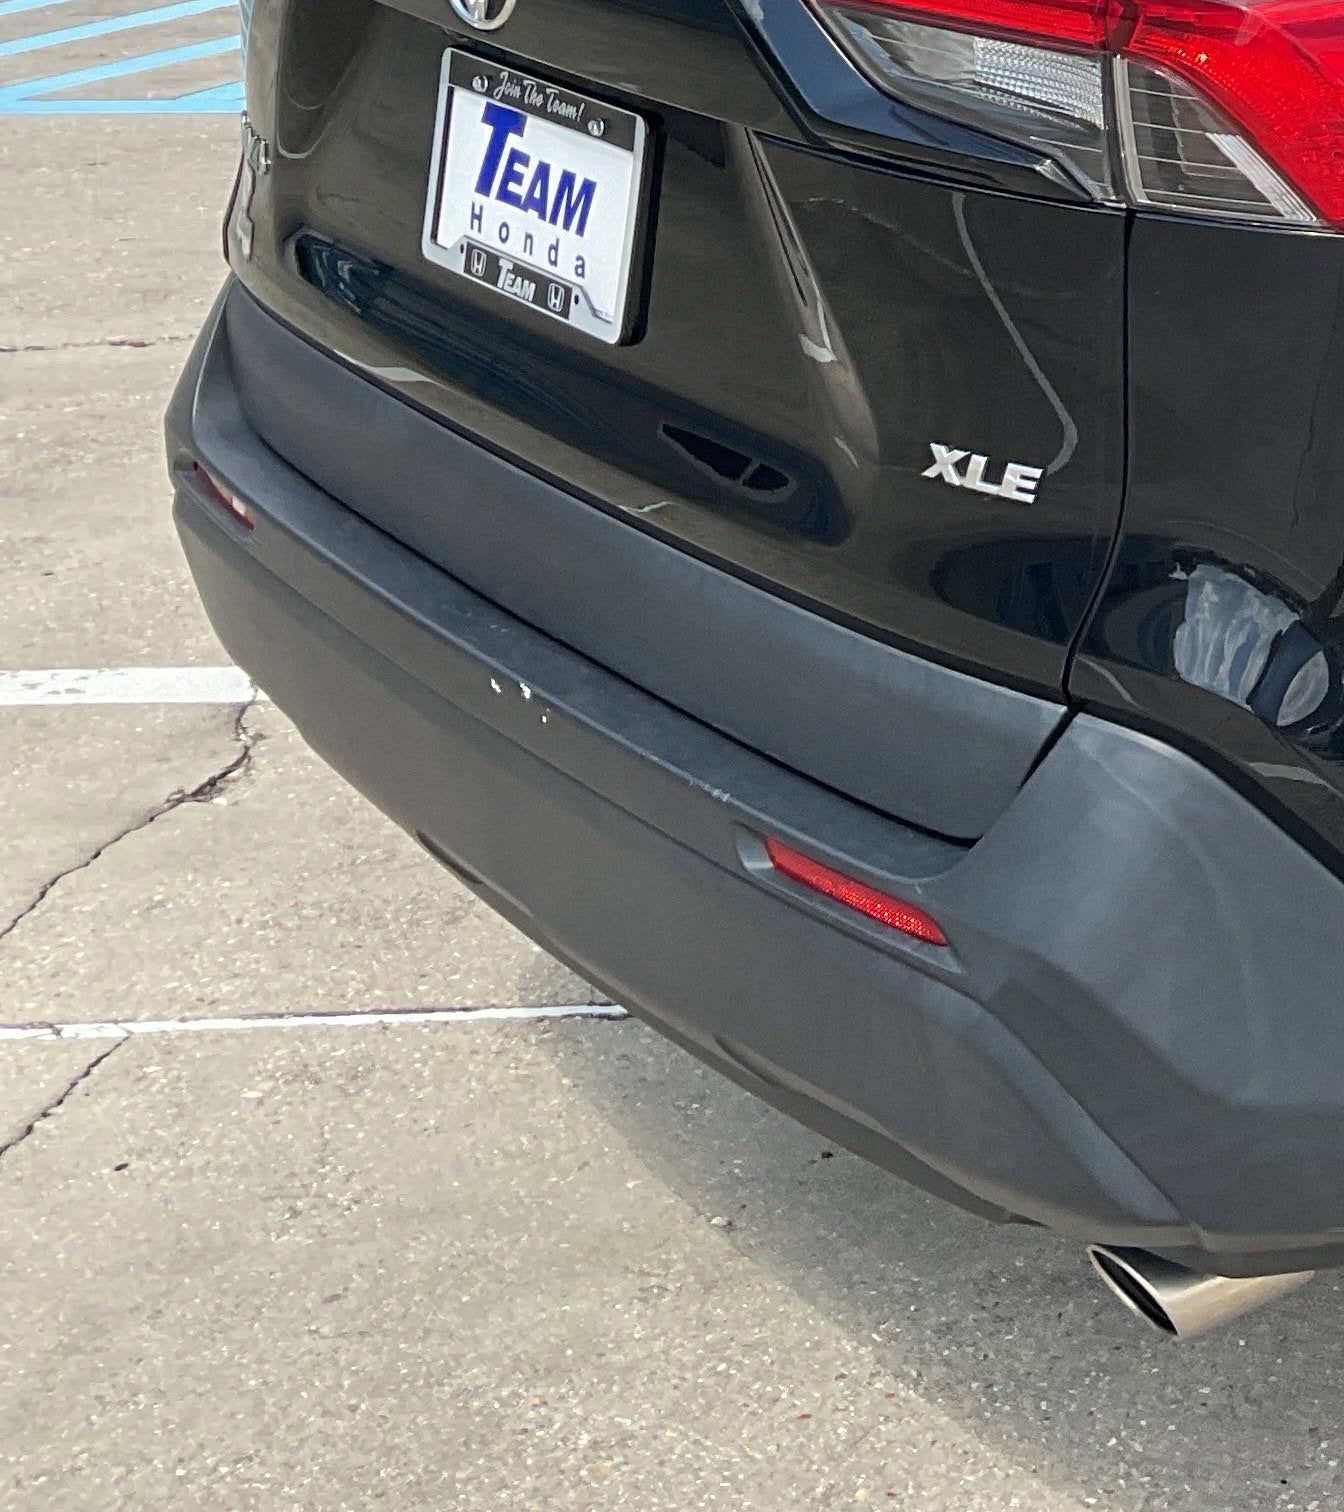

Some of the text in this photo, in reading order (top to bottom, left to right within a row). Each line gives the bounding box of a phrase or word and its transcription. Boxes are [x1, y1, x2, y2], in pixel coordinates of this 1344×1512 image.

[493, 71, 586, 122] Join The Team!
[473, 101, 597, 238] TEAM
[469, 200, 586, 280] Honda
[496, 257, 537, 303] TEAM
[920, 441, 1045, 505] XLE
